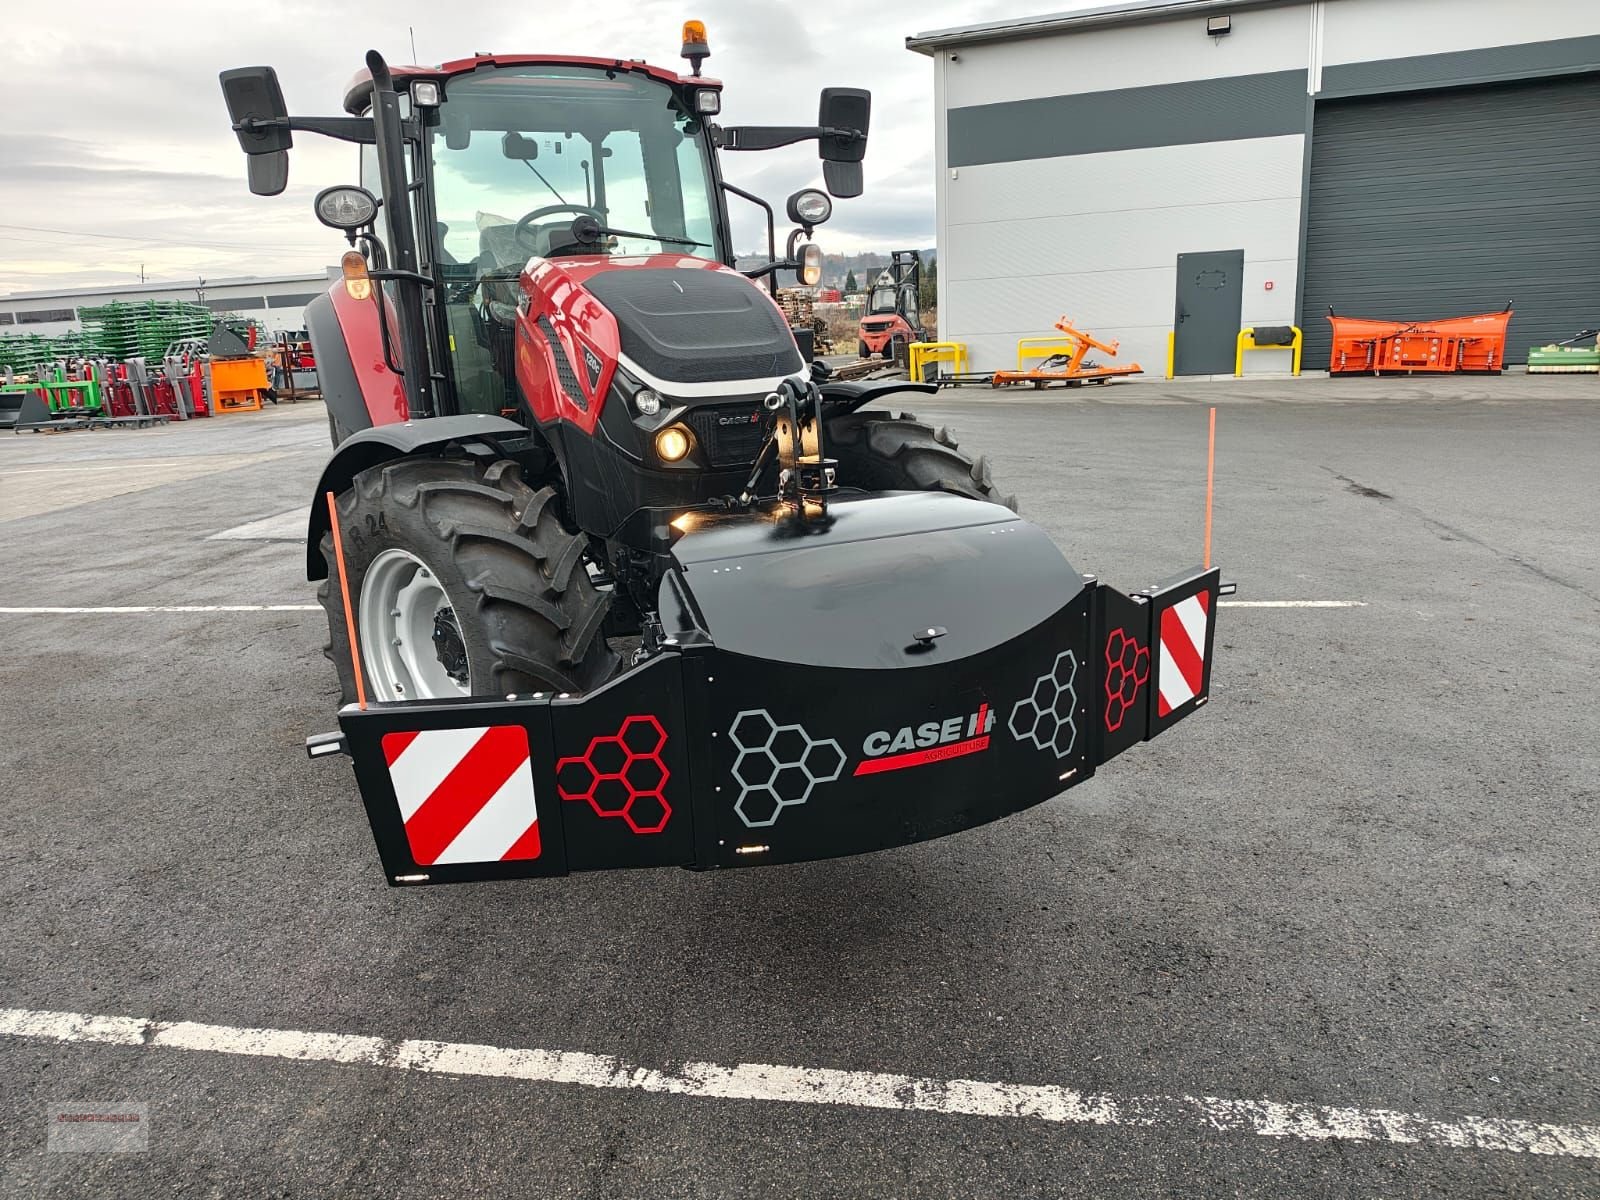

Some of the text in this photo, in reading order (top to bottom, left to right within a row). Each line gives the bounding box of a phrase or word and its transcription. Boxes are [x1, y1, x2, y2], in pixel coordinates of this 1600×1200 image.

[719, 416, 750, 426] CASE
[366, 511, 390, 537] 24
[862, 716, 964, 757] CASE
[923, 738, 987, 761] AGRICULTURE
